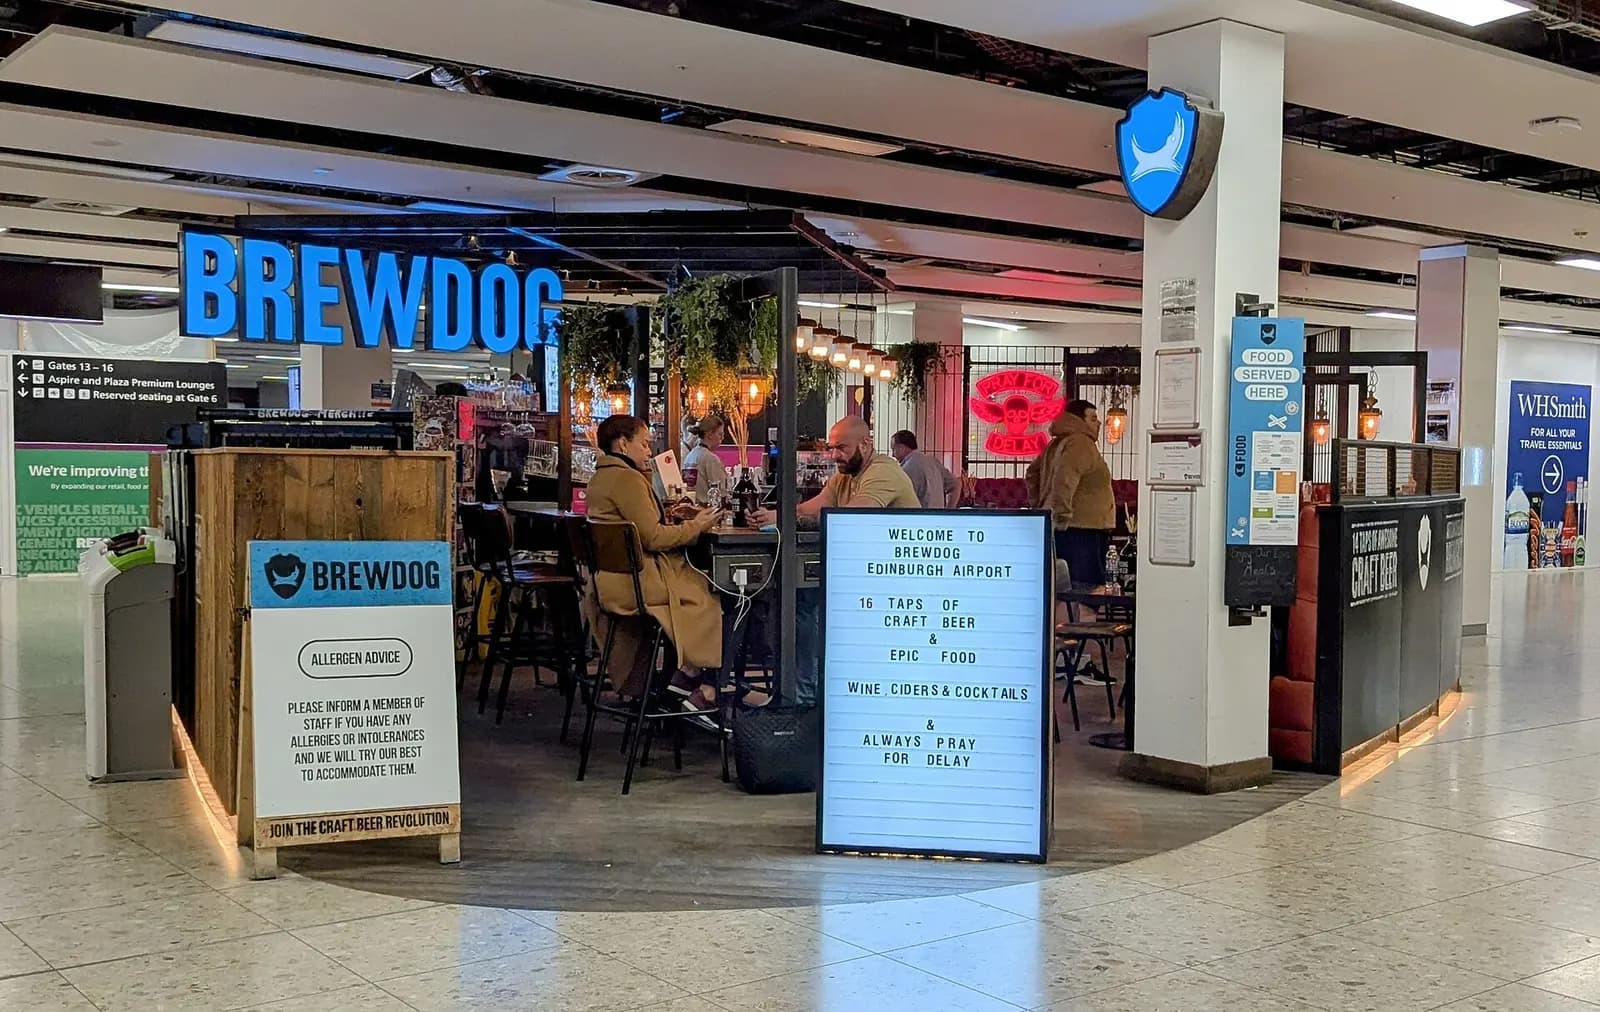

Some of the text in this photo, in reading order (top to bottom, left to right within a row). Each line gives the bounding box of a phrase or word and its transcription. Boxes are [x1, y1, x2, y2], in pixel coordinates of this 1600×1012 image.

[184, 231, 564, 353] BREWDOG
[1250, 352, 1285, 362] FOOD
[48, 361, 77, 371] Gates
[79, 363, 91, 371] 13
[102, 364, 114, 372] 16
[1242, 370, 1292, 380] SERVED
[48, 376, 215, 390] Aspire and Plaza Premium Lounges
[984, 373, 1052, 395] PRAY FOR
[93, 391, 218, 403] Reserved seating at Gate 6
[1249, 388, 1284, 398] HERE
[1517, 394, 1586, 418] WHSmith
[1530, 427, 1576, 438] FOR ALL YOUR
[993, 438, 1039, 450] DELAY
[1235, 435, 1247, 462] FOOD
[1520, 440, 1582, 450] TRAVEL ESSENTIALS
[29, 465, 68, 476] We're
[70, 465, 137, 478] improving
[61, 483, 94, 491] expanding
[25, 504, 90, 515] VEHICLES
[92, 504, 137, 515] RETAIL
[888, 528, 985, 543] WELCOME TO
[895, 547, 961, 560] BREWDOG
[313, 560, 440, 591] BREWDOG
[867, 563, 1012, 578] EDINBURGH AIRPORT
[1351, 554, 1379, 599] CRAFT
[1380, 551, 1398, 592] BEER
[859, 598, 959, 611] 16 TAPS OF
[884, 615, 975, 629] CRAFT BEER
[929, 633, 937, 645] &
[311, 650, 401, 666] ALLERGEN ADVICE
[890, 650, 976, 664] EPIC FOOD
[891, 683, 938, 696] CIDERS
[942, 685, 950, 697] &
[955, 686, 1028, 700] COCKTAILS
[288, 696, 425, 714] PLEASE INFORM A MEMBER OF
[303, 713, 412, 730] STAFF IF YOU HAVE ANY
[927, 719, 935, 731] &
[291, 729, 425, 748] ALLERGIES OR INTOLERANCES
[863, 734, 976, 750] ALWAYS PRAY
[294, 746, 422, 765] AND WE WILL TRY OUR BEST
[884, 752, 971, 768] FOR DELAY
[301, 763, 417, 782] TO ACCOMMODATE THEM.
[270, 811, 449, 839] JOIN THE CRAFT BEER REVOLUTION
